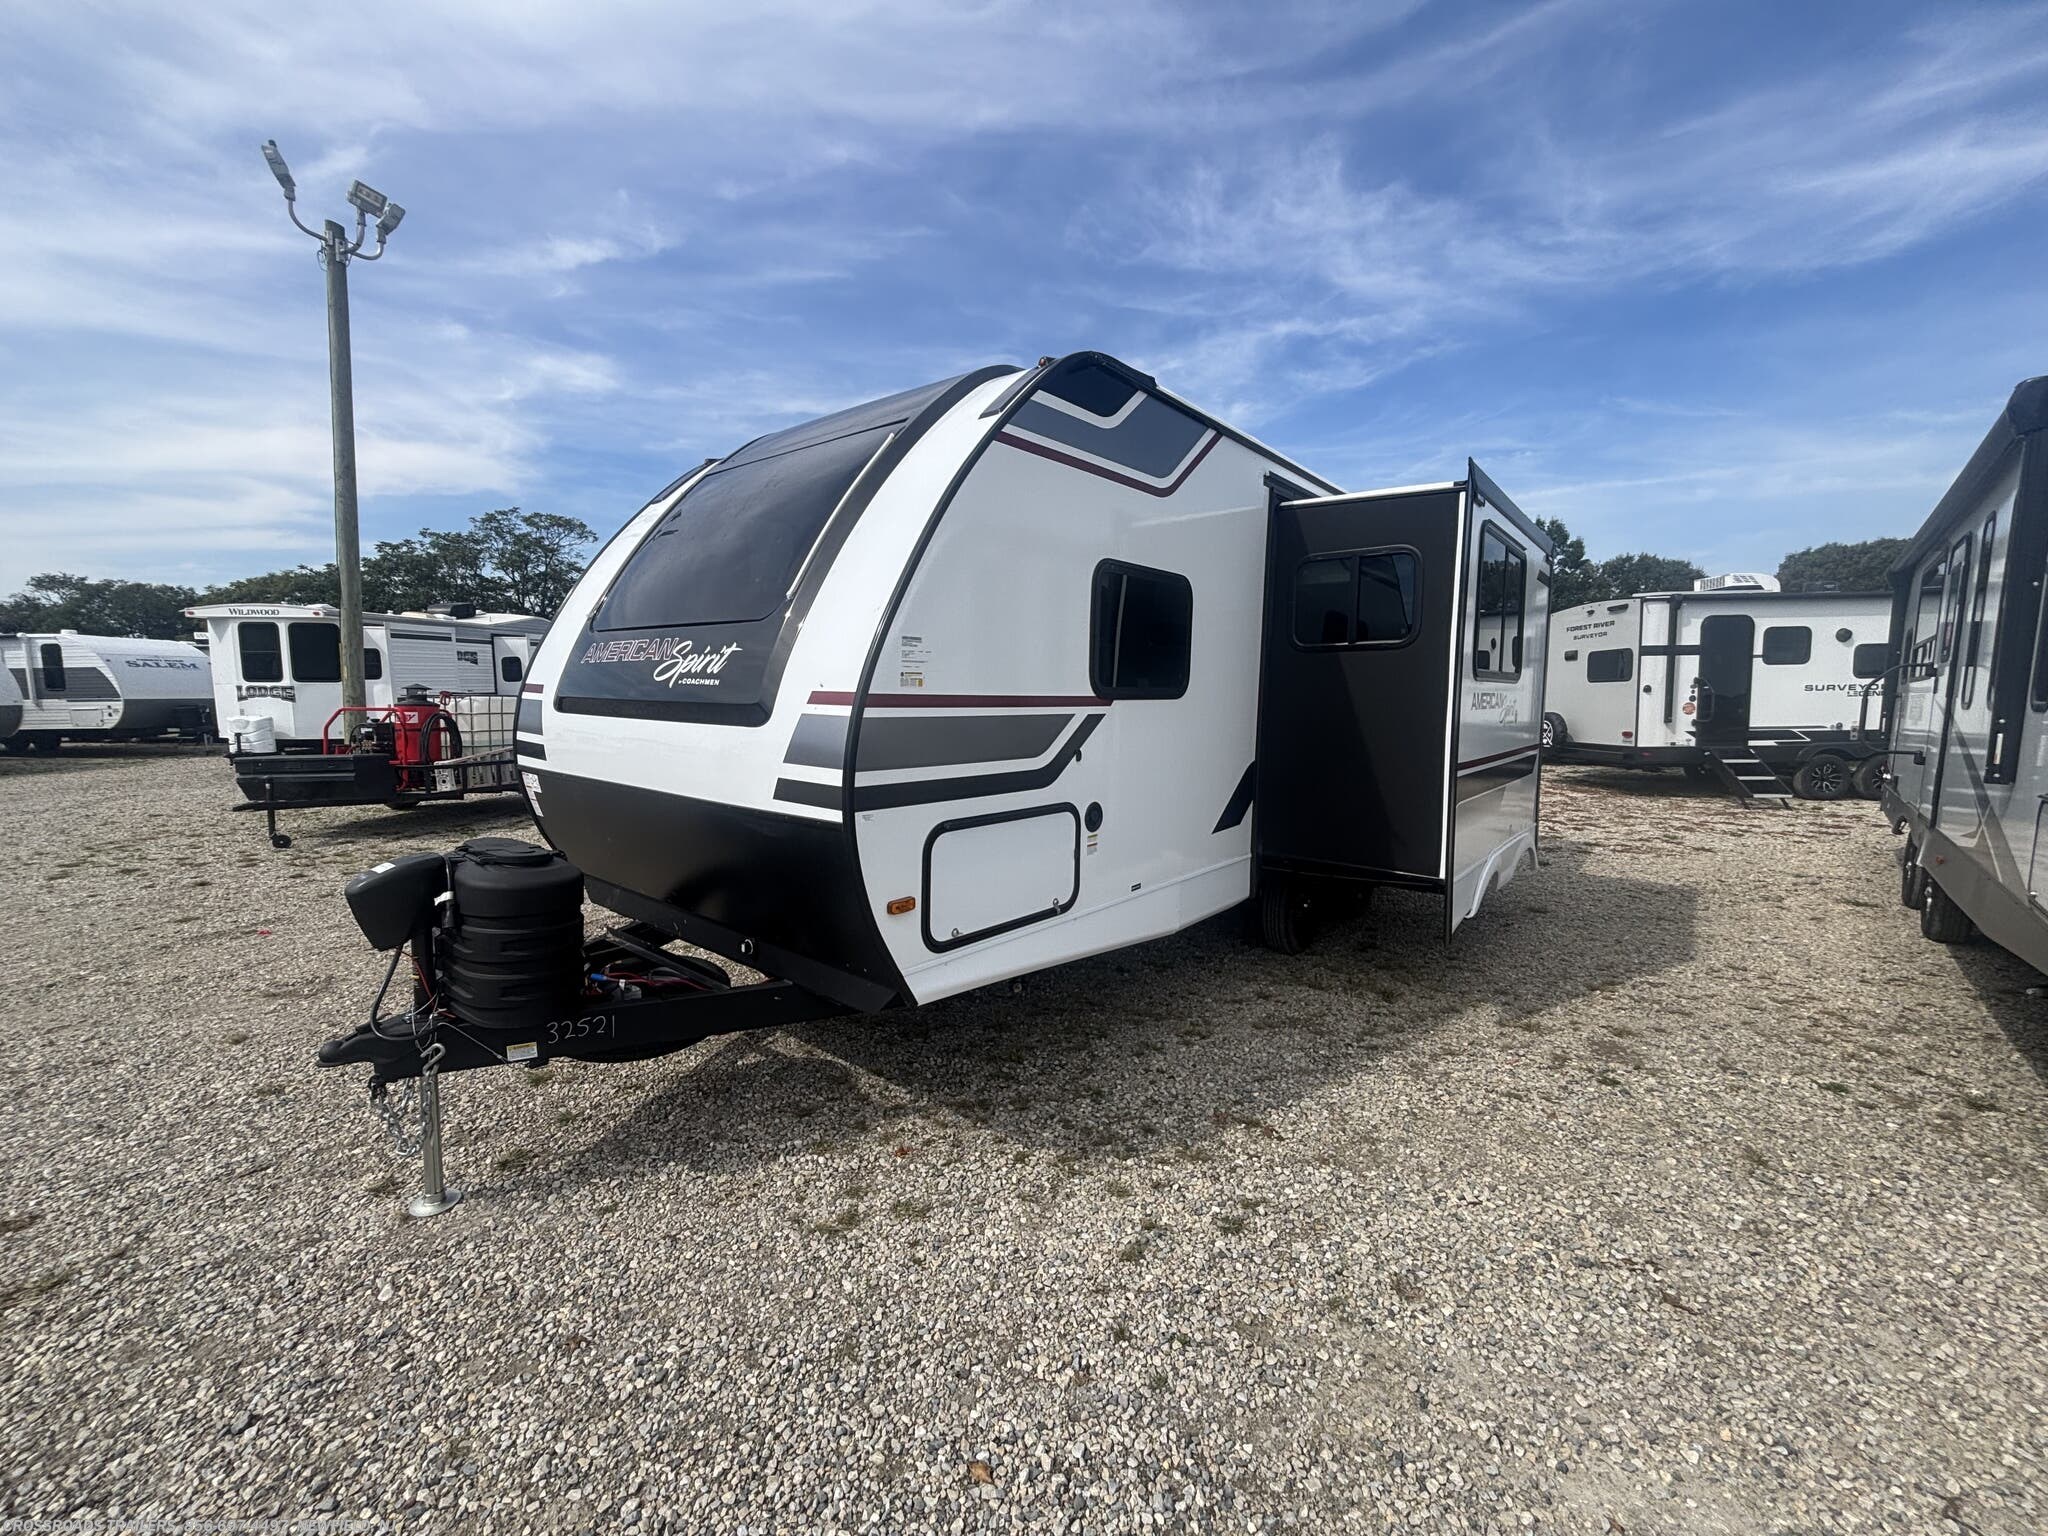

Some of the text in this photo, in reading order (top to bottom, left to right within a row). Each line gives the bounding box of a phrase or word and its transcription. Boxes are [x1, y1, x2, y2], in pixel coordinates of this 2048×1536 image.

[1566, 620, 1615, 632] FOREST RIVER
[1573, 631, 1608, 640] SURVEYOR
[125, 660, 200, 670] SALEM
[581, 637, 743, 688] AMERICAN Spirit
[682, 678, 720, 686] COACHMEN
[236, 685, 296, 703] LODGE
[546, 1015, 615, 1044] 32521
